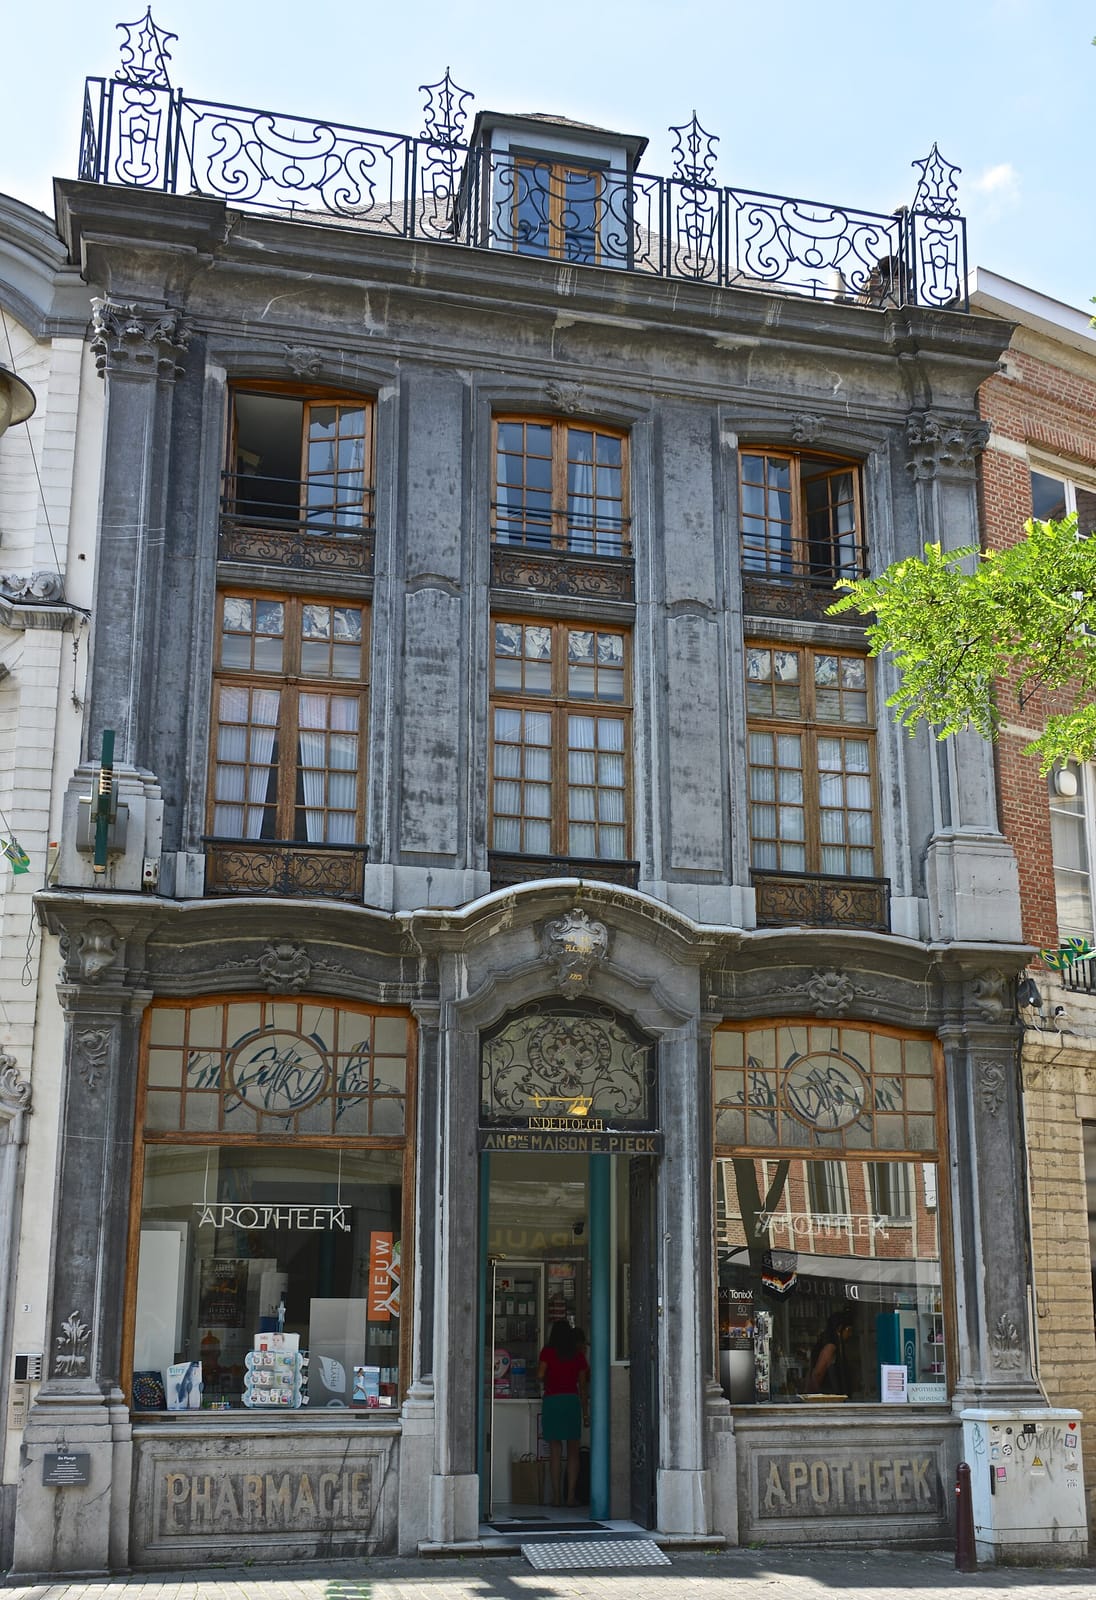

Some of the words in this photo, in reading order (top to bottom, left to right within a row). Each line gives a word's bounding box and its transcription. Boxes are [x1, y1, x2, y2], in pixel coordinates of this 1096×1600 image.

[531, 1135, 588, 1151] MAISON
[608, 1138, 656, 1152] PIECK
[373, 1239, 391, 1312] NIEUW
[164, 1471, 370, 1532] PHARMACIE
[764, 1457, 932, 1508] APOTHEEK
